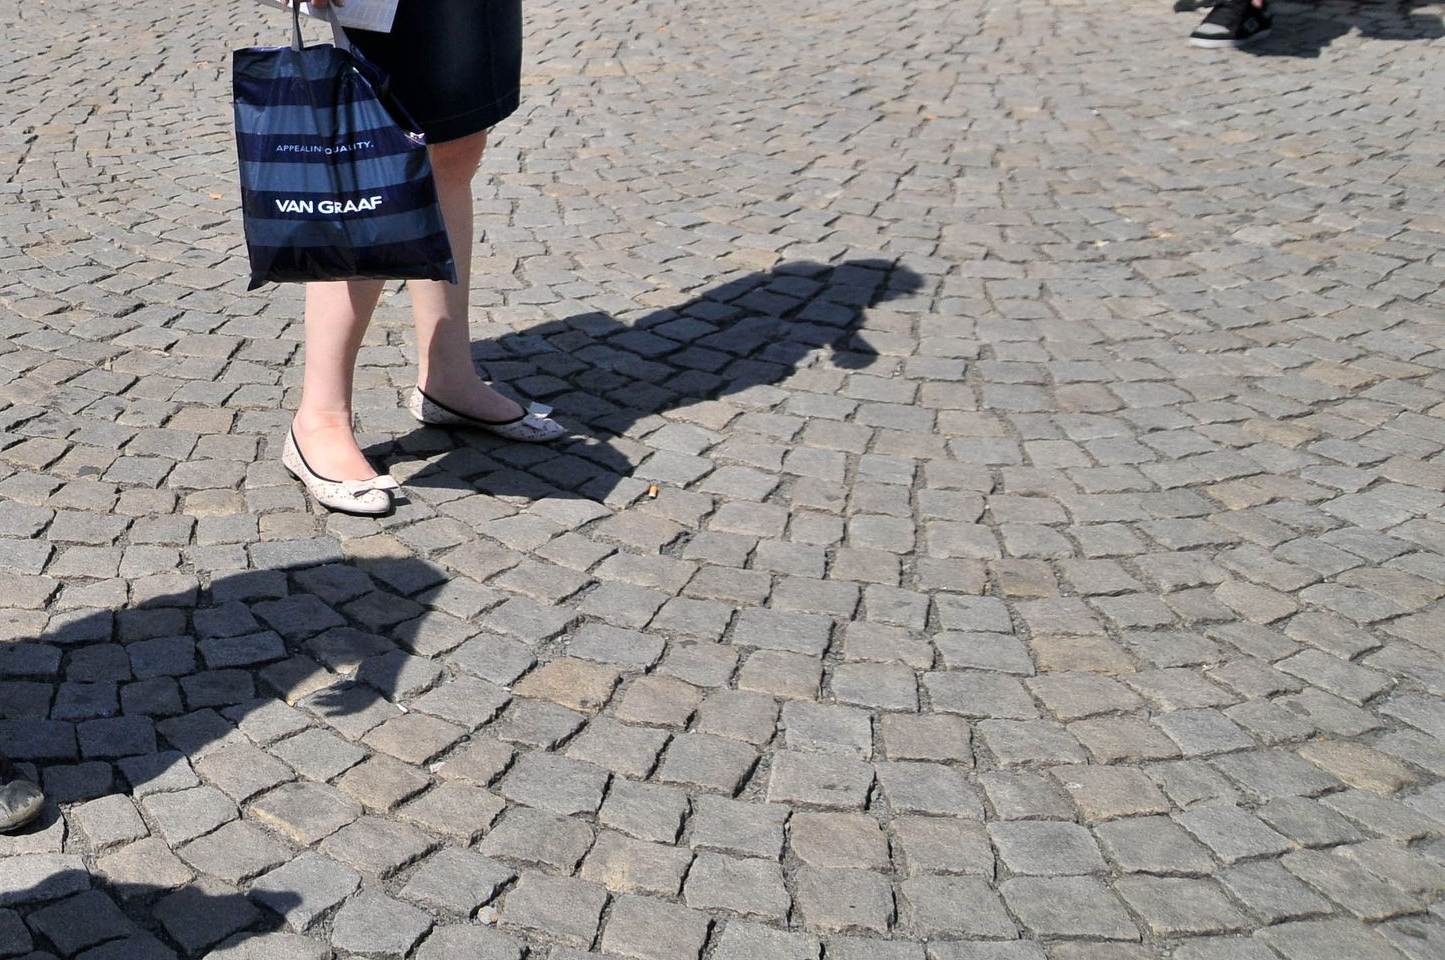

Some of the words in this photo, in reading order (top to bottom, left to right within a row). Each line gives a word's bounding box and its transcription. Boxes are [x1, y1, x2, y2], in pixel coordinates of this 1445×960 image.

[275, 144, 323, 154] APPEALIN
[275, 198, 314, 214] VAN
[317, 195, 383, 215] GRAAF
